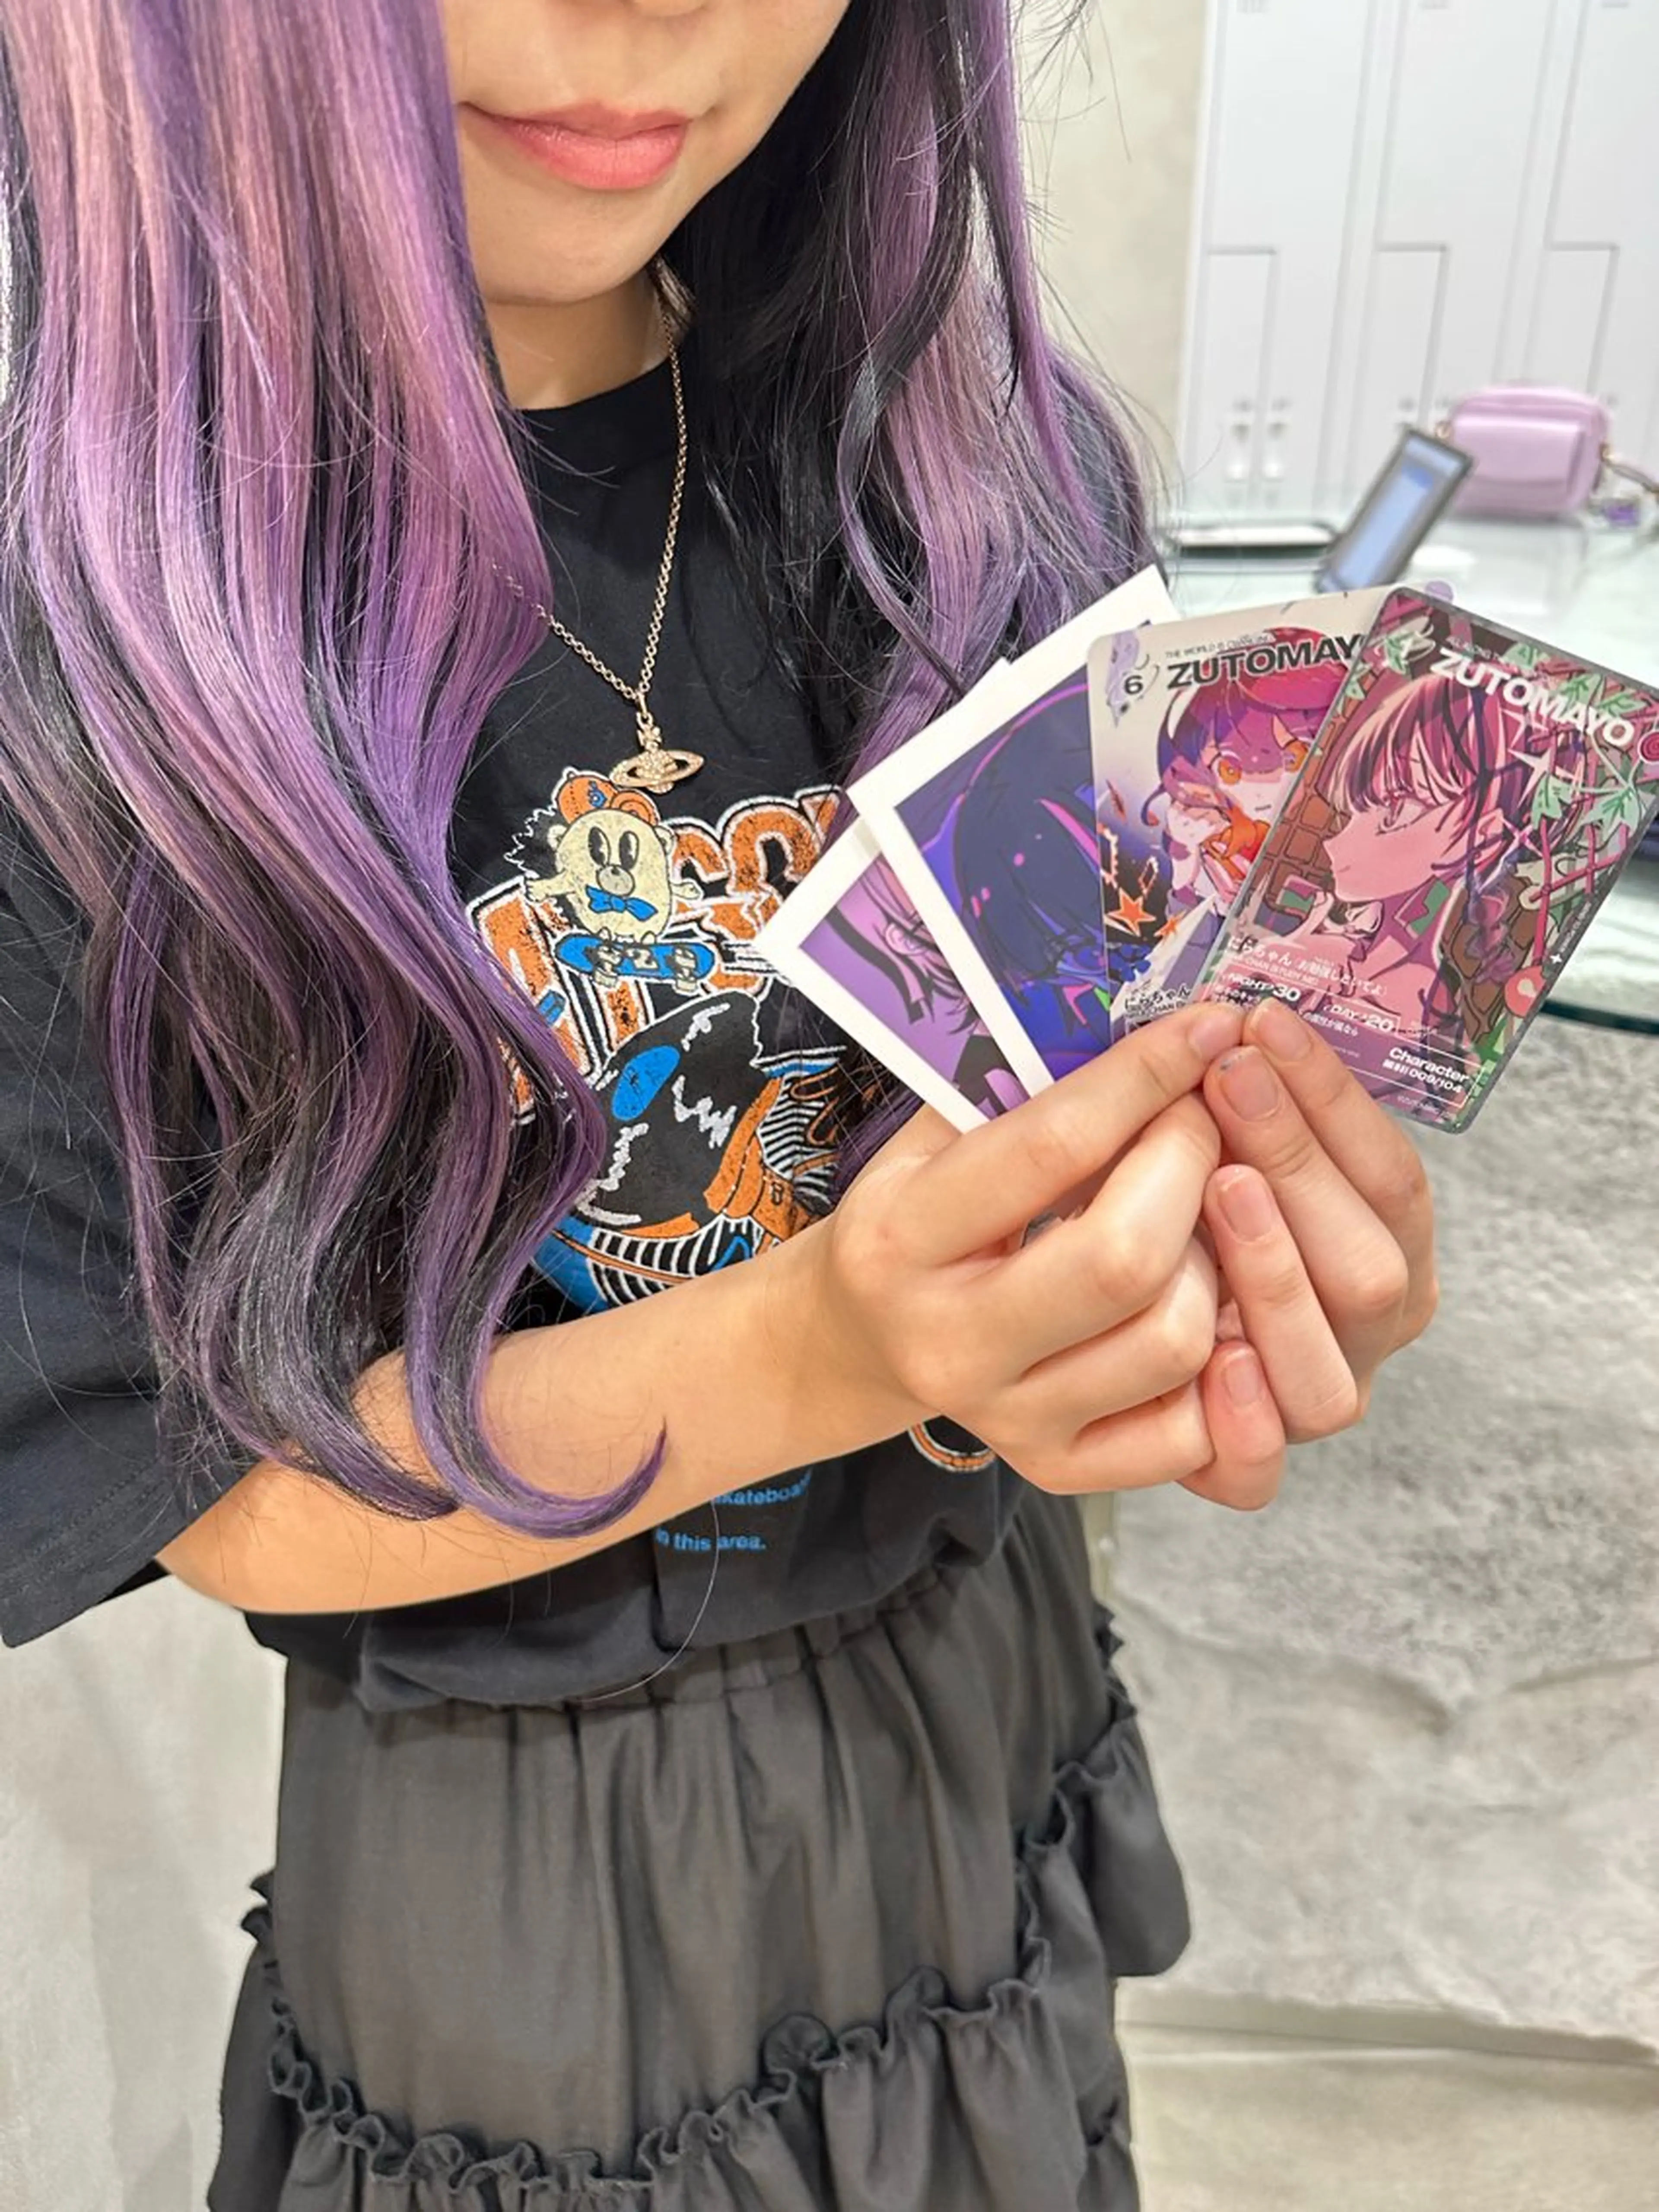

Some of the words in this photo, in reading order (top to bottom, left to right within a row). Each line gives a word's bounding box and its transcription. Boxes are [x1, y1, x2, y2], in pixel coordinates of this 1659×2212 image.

[1167, 634, 1365, 689] ZUTOMAY
[1124, 675, 1143, 694] 6
[1430, 647, 1634, 747] ZUTOMAYO
[1273, 982, 1301, 1001] 30
[1365, 1014, 1394, 1032] 20
[1389, 1047, 1470, 1082] Character
[674, 1532, 711, 1551] this
[717, 1534, 767, 1551] area.
